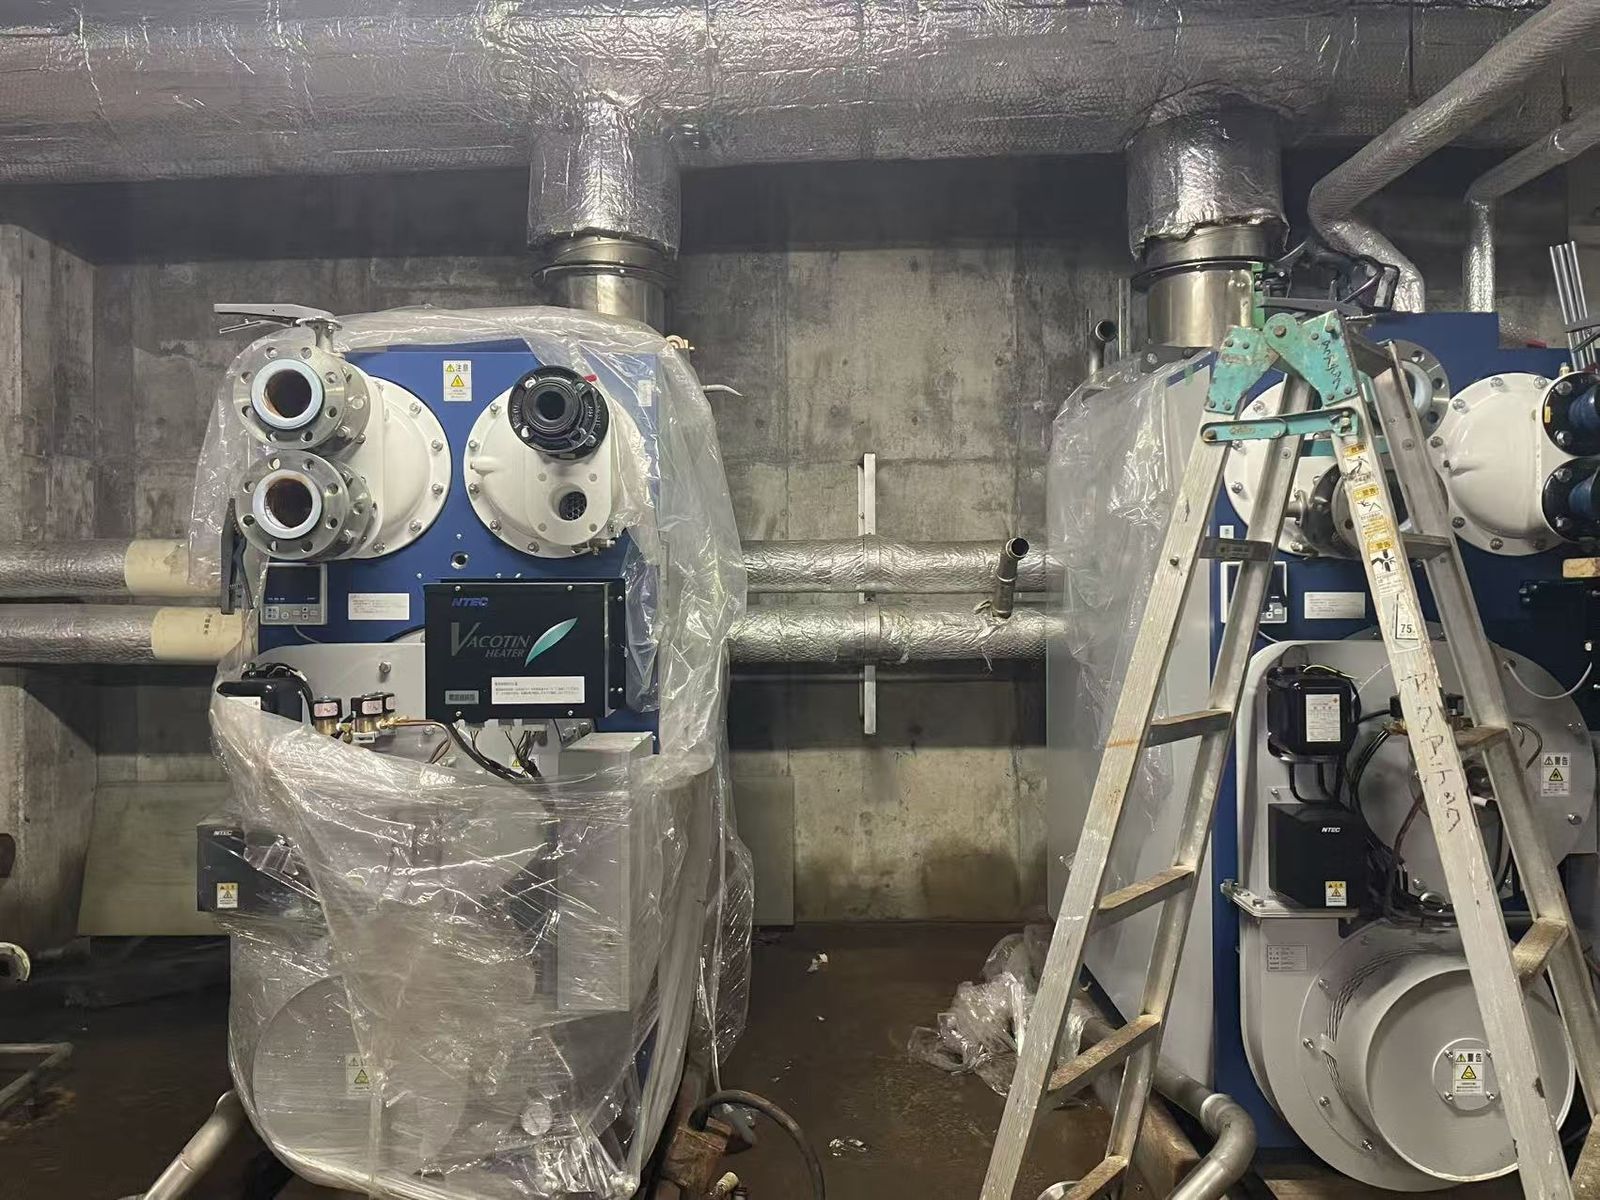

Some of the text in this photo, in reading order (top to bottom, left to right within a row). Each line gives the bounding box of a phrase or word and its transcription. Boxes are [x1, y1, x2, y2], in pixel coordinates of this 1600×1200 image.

[455, 363, 469, 372] 注意
[452, 597, 489, 607] NTEC
[451, 622, 531, 657] VACOTIN
[485, 649, 525, 658] HEATER
[1555, 756, 1568, 765] 警告
[1468, 1053, 1481, 1062] 警告
